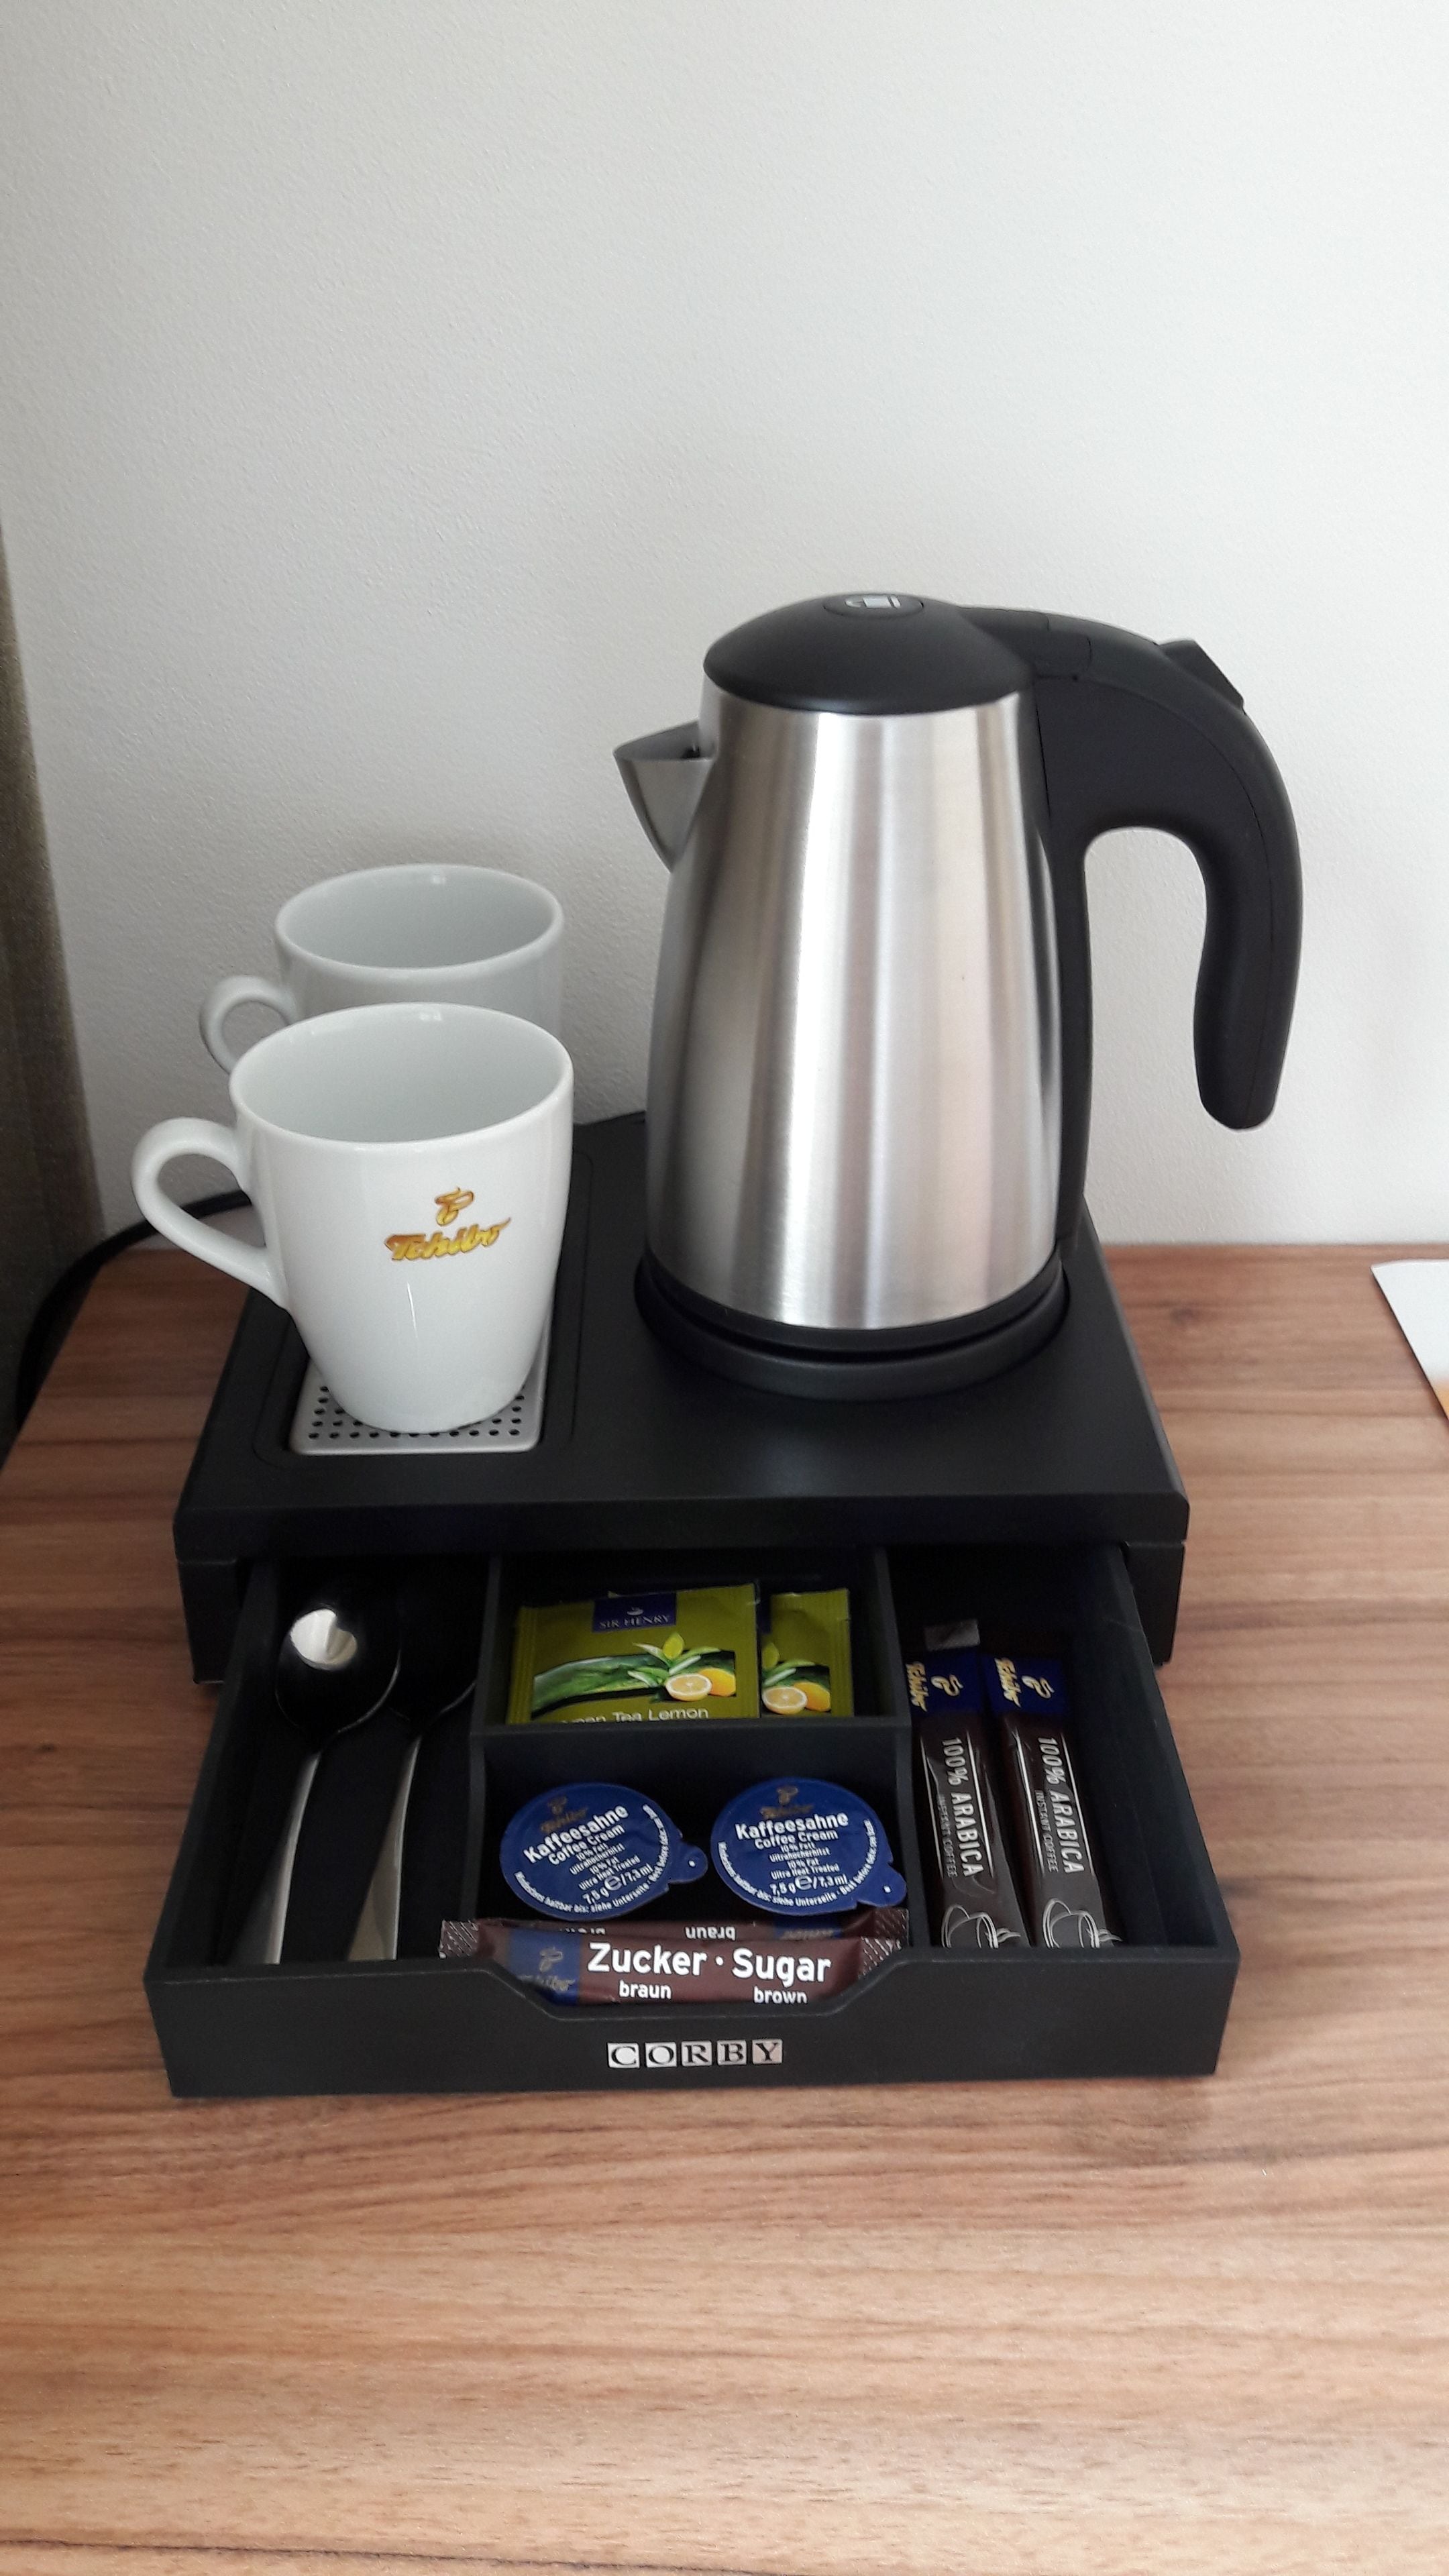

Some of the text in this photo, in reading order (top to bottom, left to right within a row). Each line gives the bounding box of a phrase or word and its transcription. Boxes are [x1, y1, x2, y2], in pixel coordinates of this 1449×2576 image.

[384, 1217, 511, 1260] Tchibo
[612, 1711, 642, 1722] Tea
[649, 1708, 708, 1721] Lemon
[942, 1737, 984, 1876] 100% ARABICA
[1038, 1737, 1085, 1873] 100% ARABICA
[523, 1805, 629, 1863] Kaffeesahne
[735, 1812, 849, 1840] Kaffeesahne
[754, 1829, 839, 1849] Coffee Cream
[548, 1839, 588, 1865] Coffee
[588, 1824, 625, 1845] Cream
[1043, 1833, 1059, 1873] COFFEE
[578, 1878, 598, 1890] Ultra
[771, 1870, 791, 1880] Ultra
[685, 1926, 736, 1940] braun
[588, 1943, 707, 1976] Zucker
[732, 1947, 831, 1988] Sugar
[619, 1980, 808, 2004] braun brown
[609, 2040, 781, 2067] CORBY
